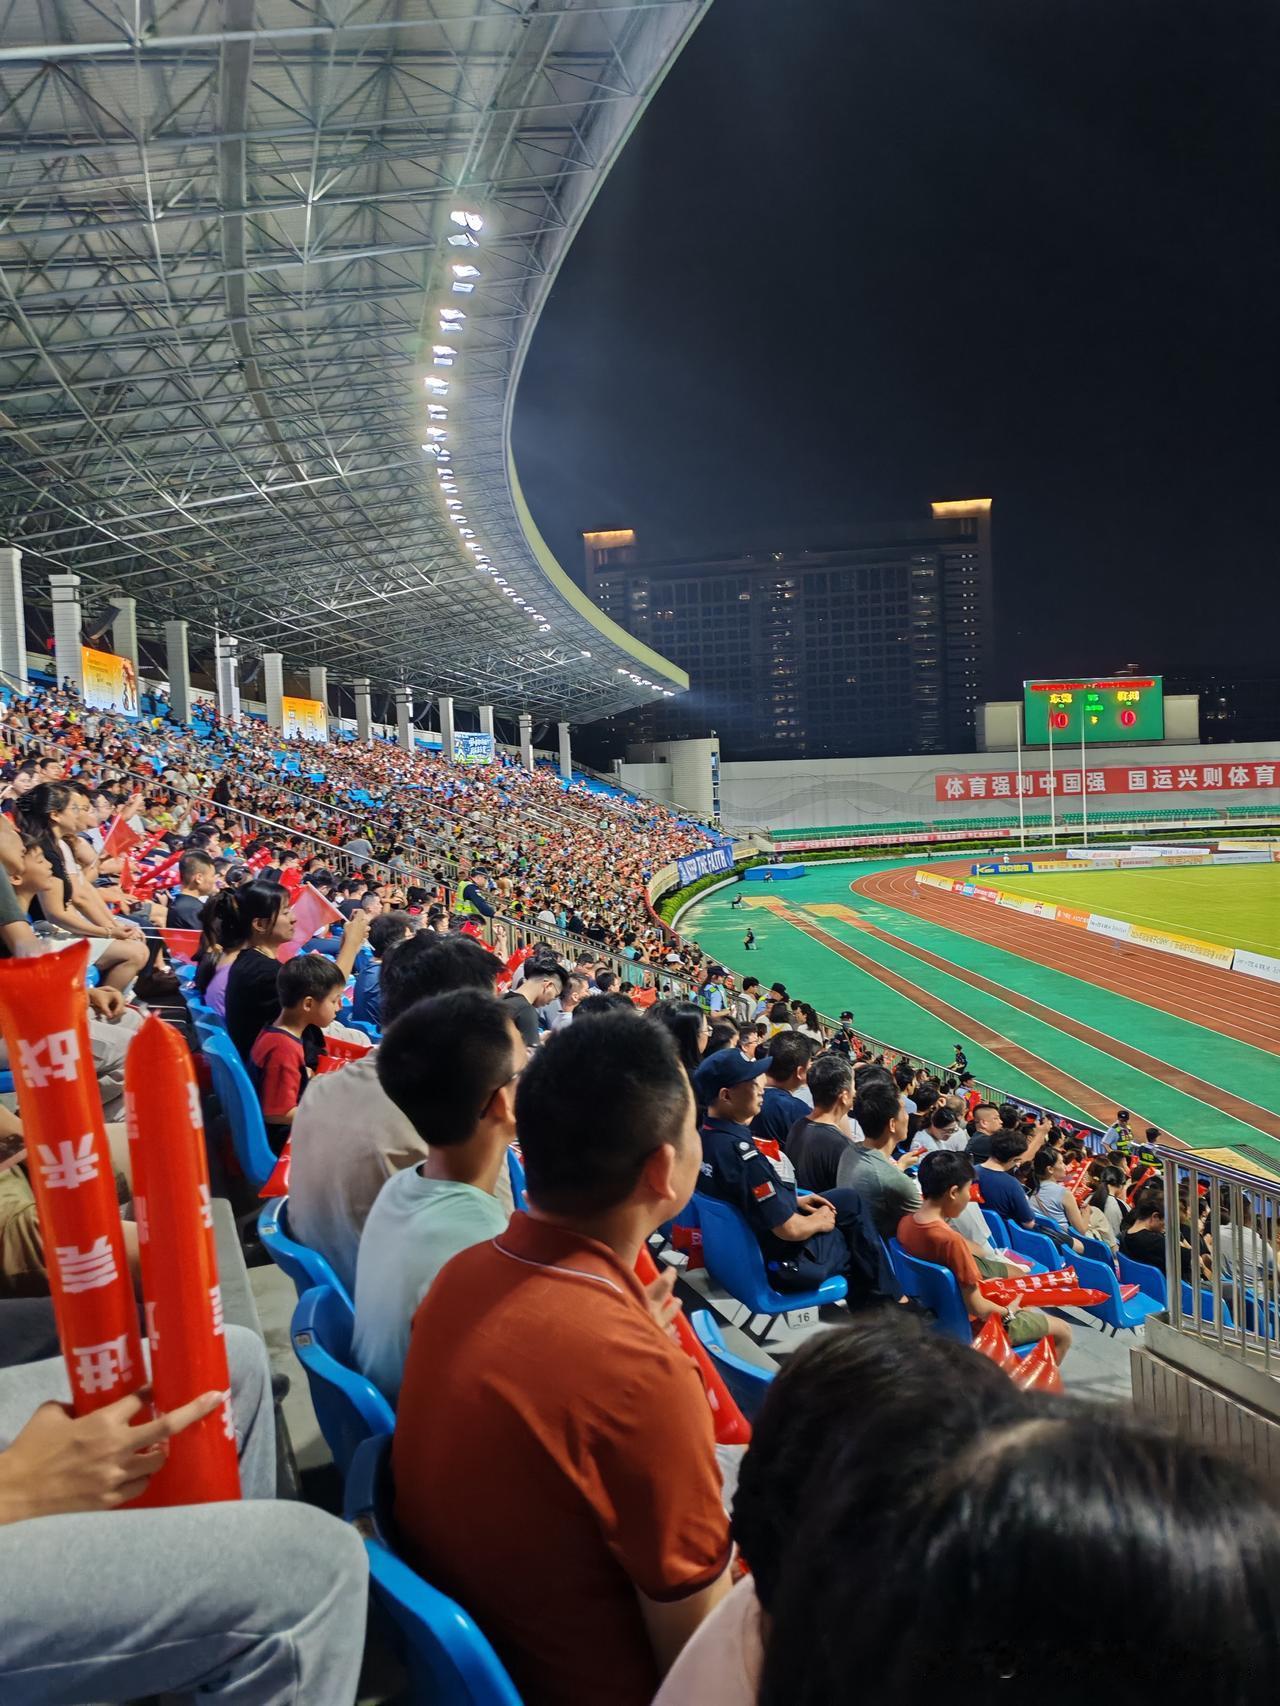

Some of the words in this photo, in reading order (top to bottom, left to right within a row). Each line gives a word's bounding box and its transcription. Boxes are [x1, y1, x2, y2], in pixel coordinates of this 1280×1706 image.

[945, 772, 1106, 798] 体育强则中国强
[1128, 765, 1276, 790] 国运兴则体育
[798, 1312, 810, 1323] 16
